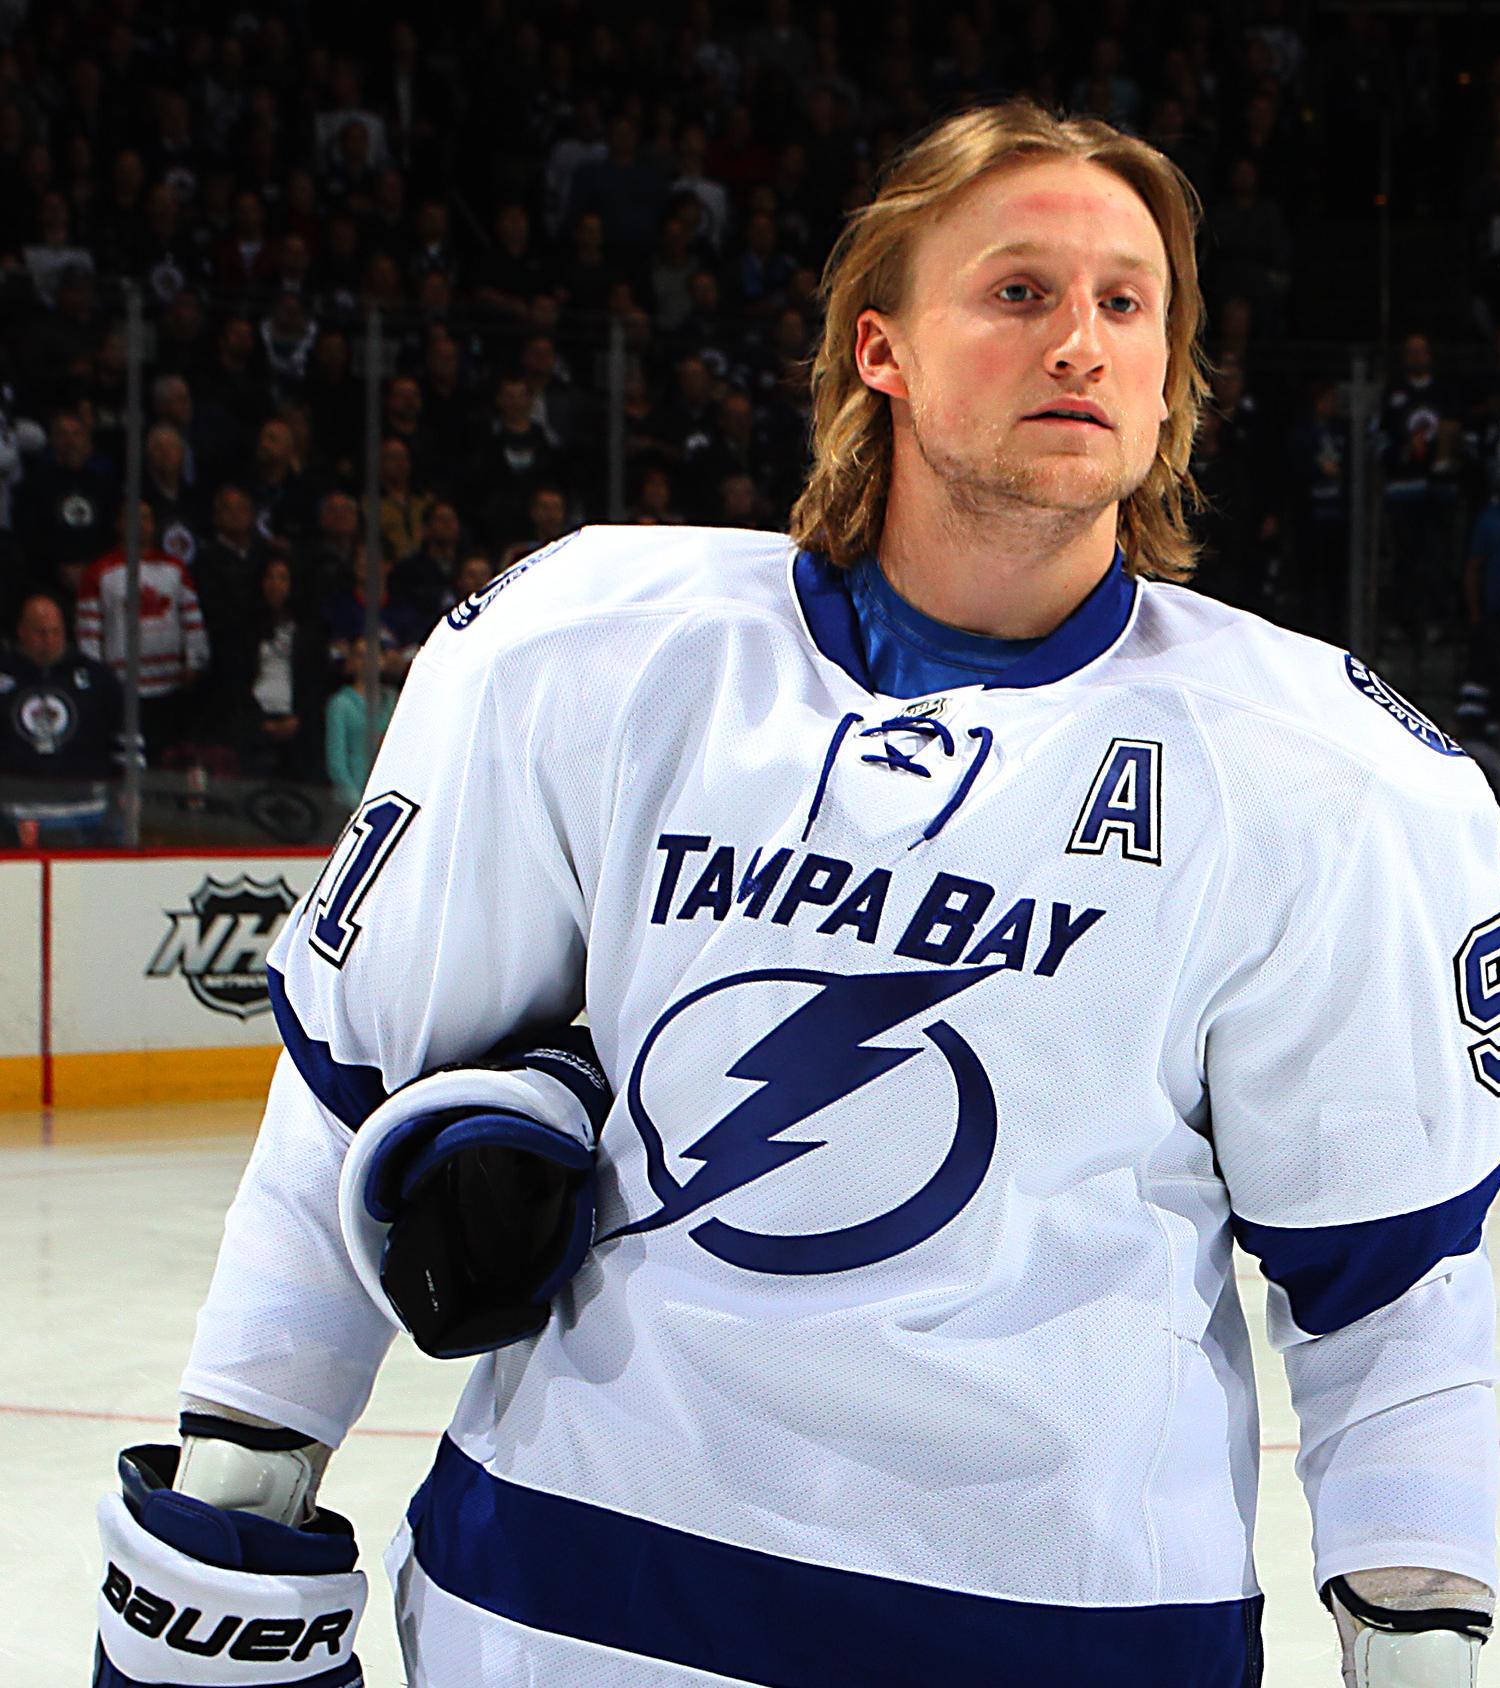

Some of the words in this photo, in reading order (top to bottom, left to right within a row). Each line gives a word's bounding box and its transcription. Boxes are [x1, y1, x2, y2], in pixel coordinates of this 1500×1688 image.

[1065, 738, 1162, 866] A
[144, 909, 296, 976] NH
[309, 789, 422, 971] 1
[650, 833, 892, 944] TAMPA
[894, 872, 1106, 978] BAY
